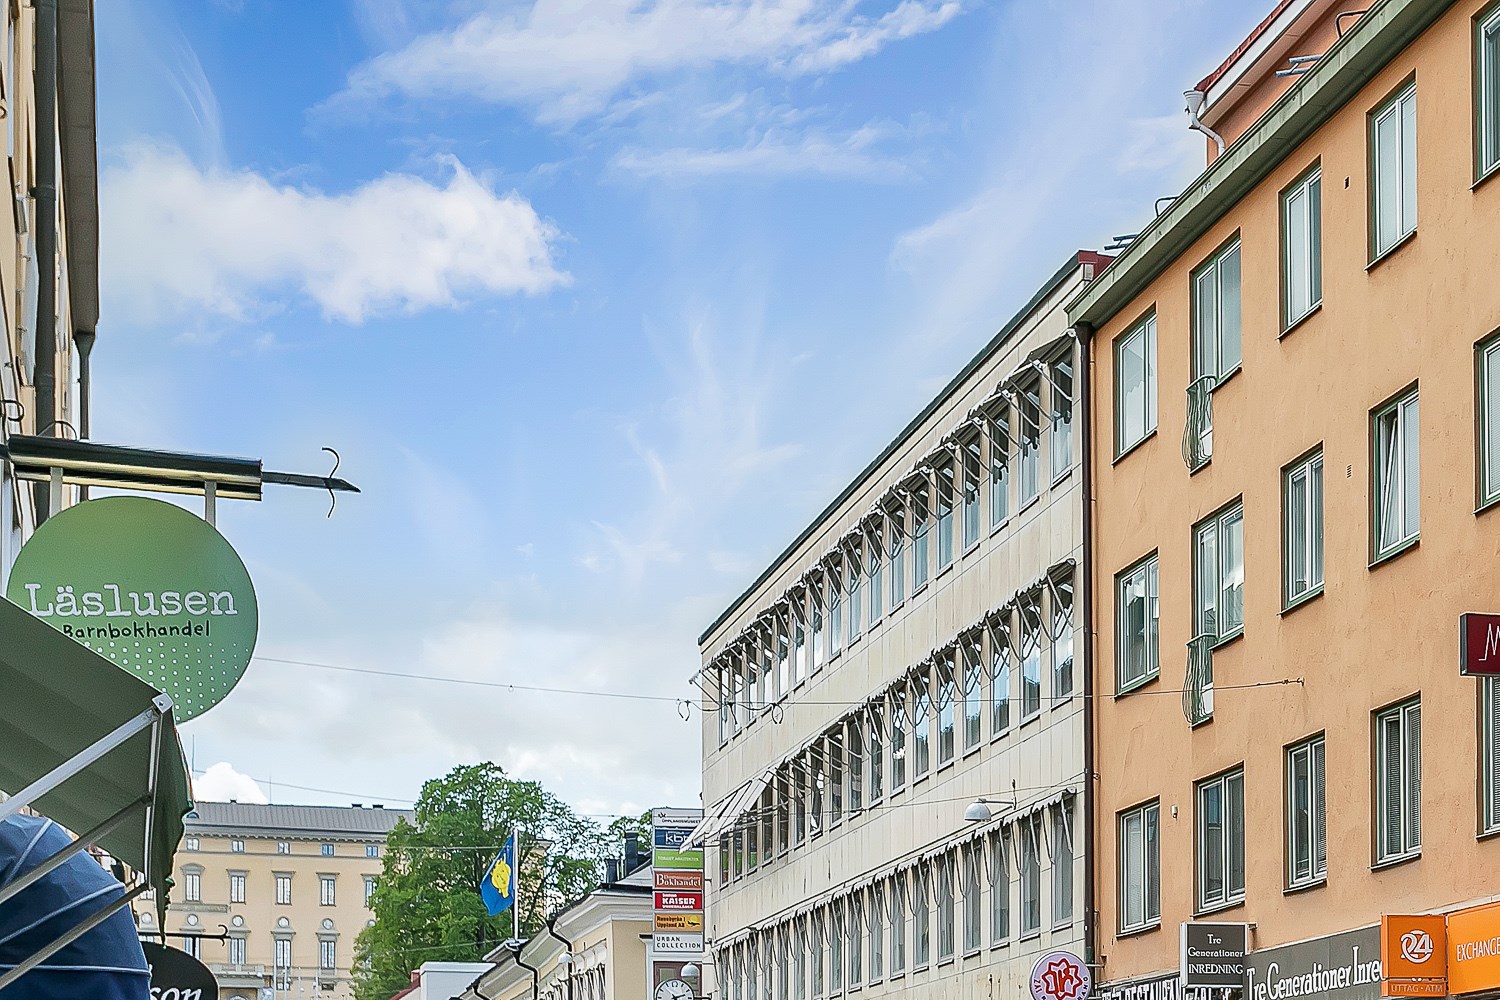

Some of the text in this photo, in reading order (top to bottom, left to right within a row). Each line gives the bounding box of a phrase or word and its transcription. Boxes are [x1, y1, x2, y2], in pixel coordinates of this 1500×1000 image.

[24, 583, 238, 618] Läslusen
[63, 620, 210, 639] Barnbokhandel
[656, 874, 701, 886] Bokhandel
[1207, 934, 1222, 944] Tre
[1187, 947, 1244, 957] Generationer
[1188, 963, 1244, 974] INREDNING
[1266, 962, 1352, 1000] Generationer
